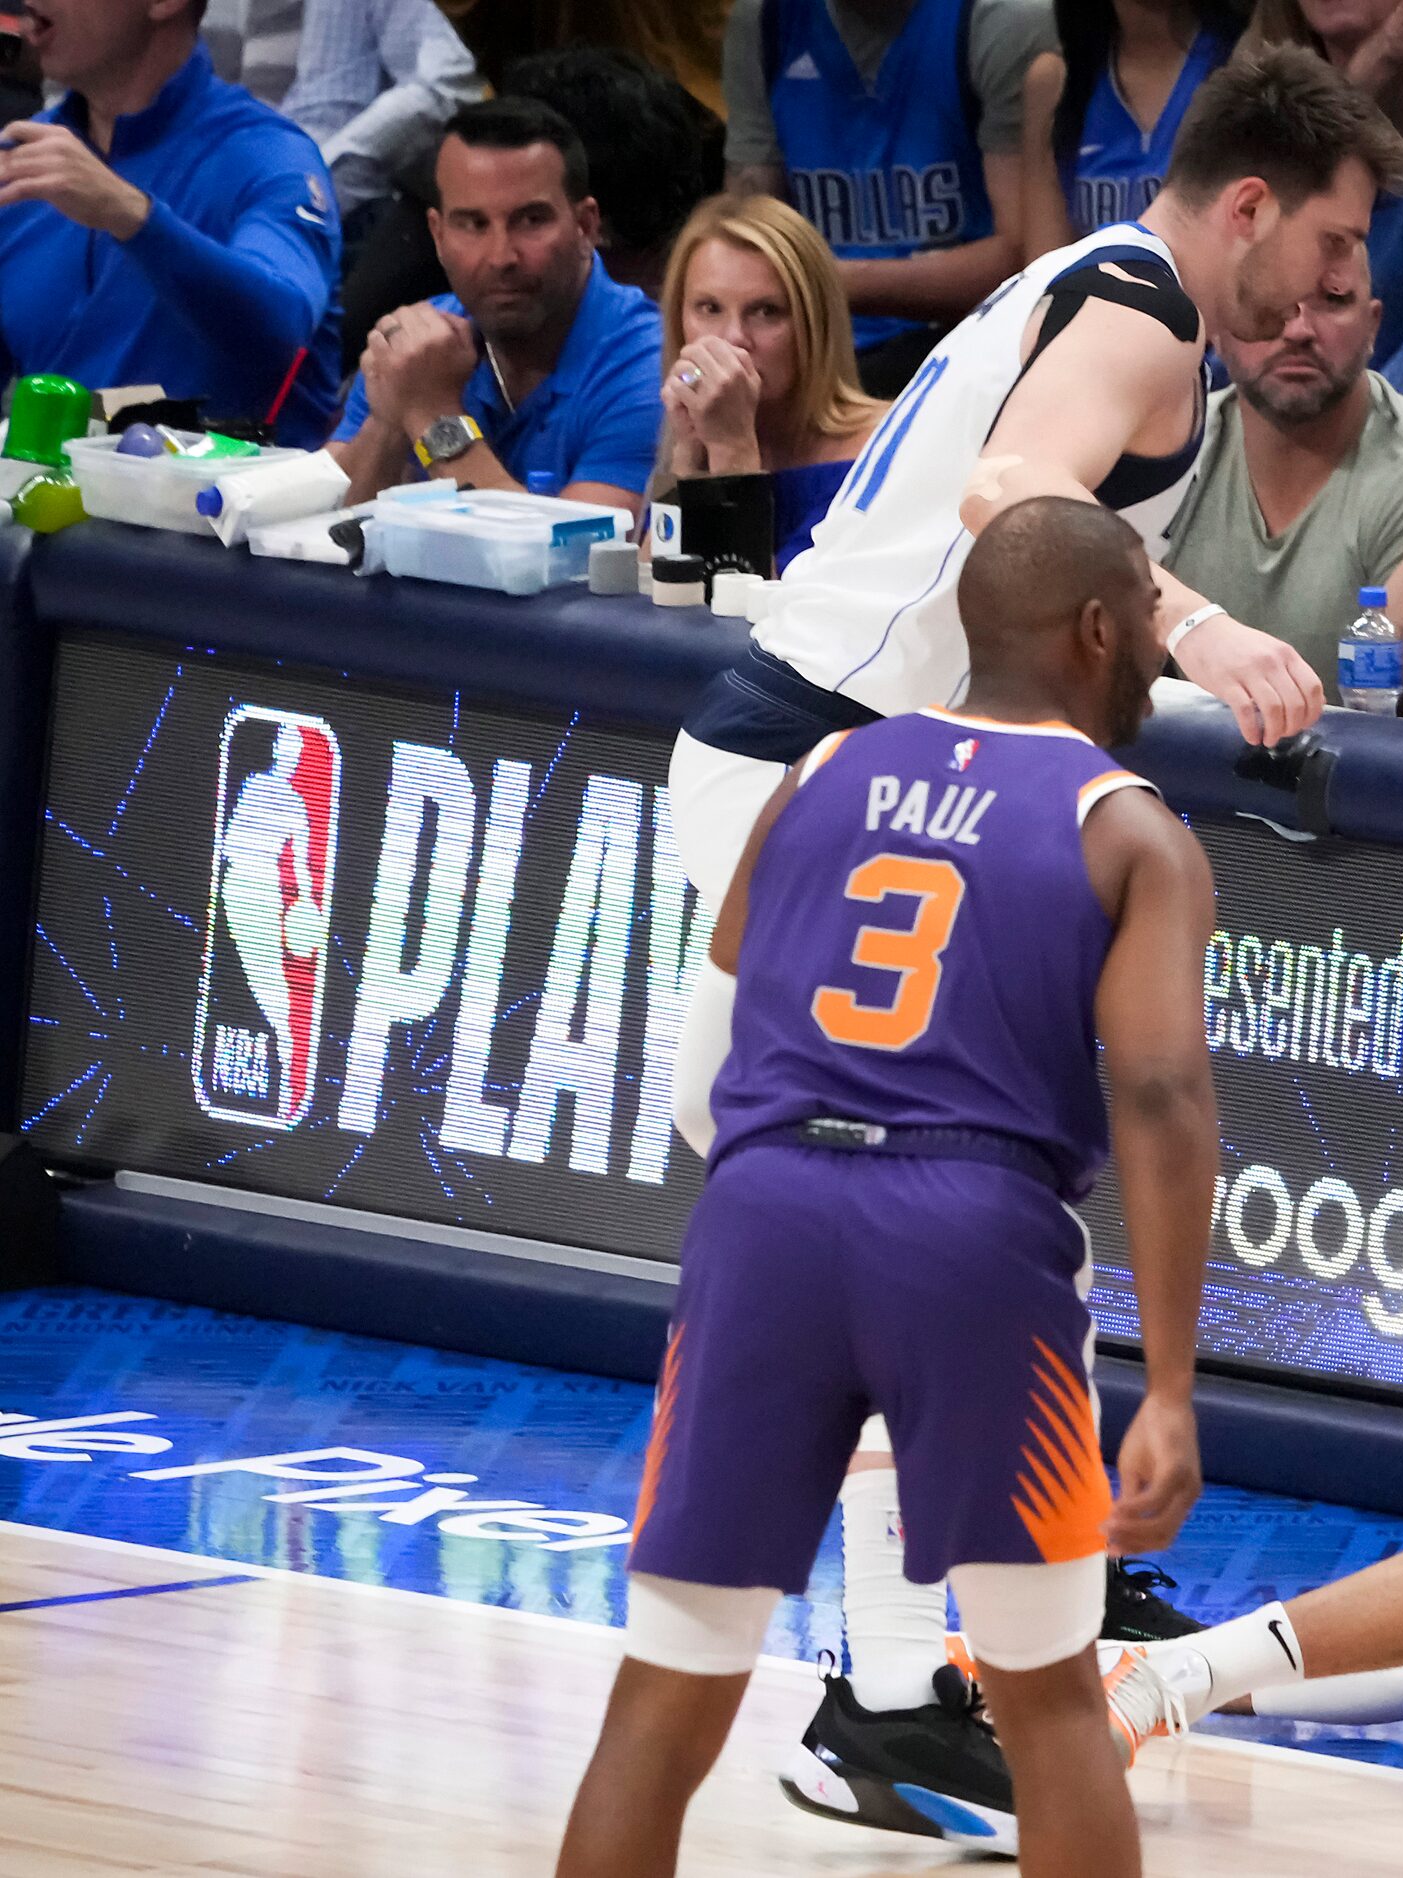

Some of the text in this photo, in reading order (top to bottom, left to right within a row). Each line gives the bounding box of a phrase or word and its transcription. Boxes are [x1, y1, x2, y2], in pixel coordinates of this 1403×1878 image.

[791, 161, 965, 250] DALLAS
[865, 774, 998, 847] PAUL
[811, 852, 967, 1053] 3
[1, 1321, 154, 1334] NTHONY
[319, 1379, 417, 1392] NICK
[437, 1380, 520, 1393] VAN
[0, 1410, 634, 1552] le Pixel
